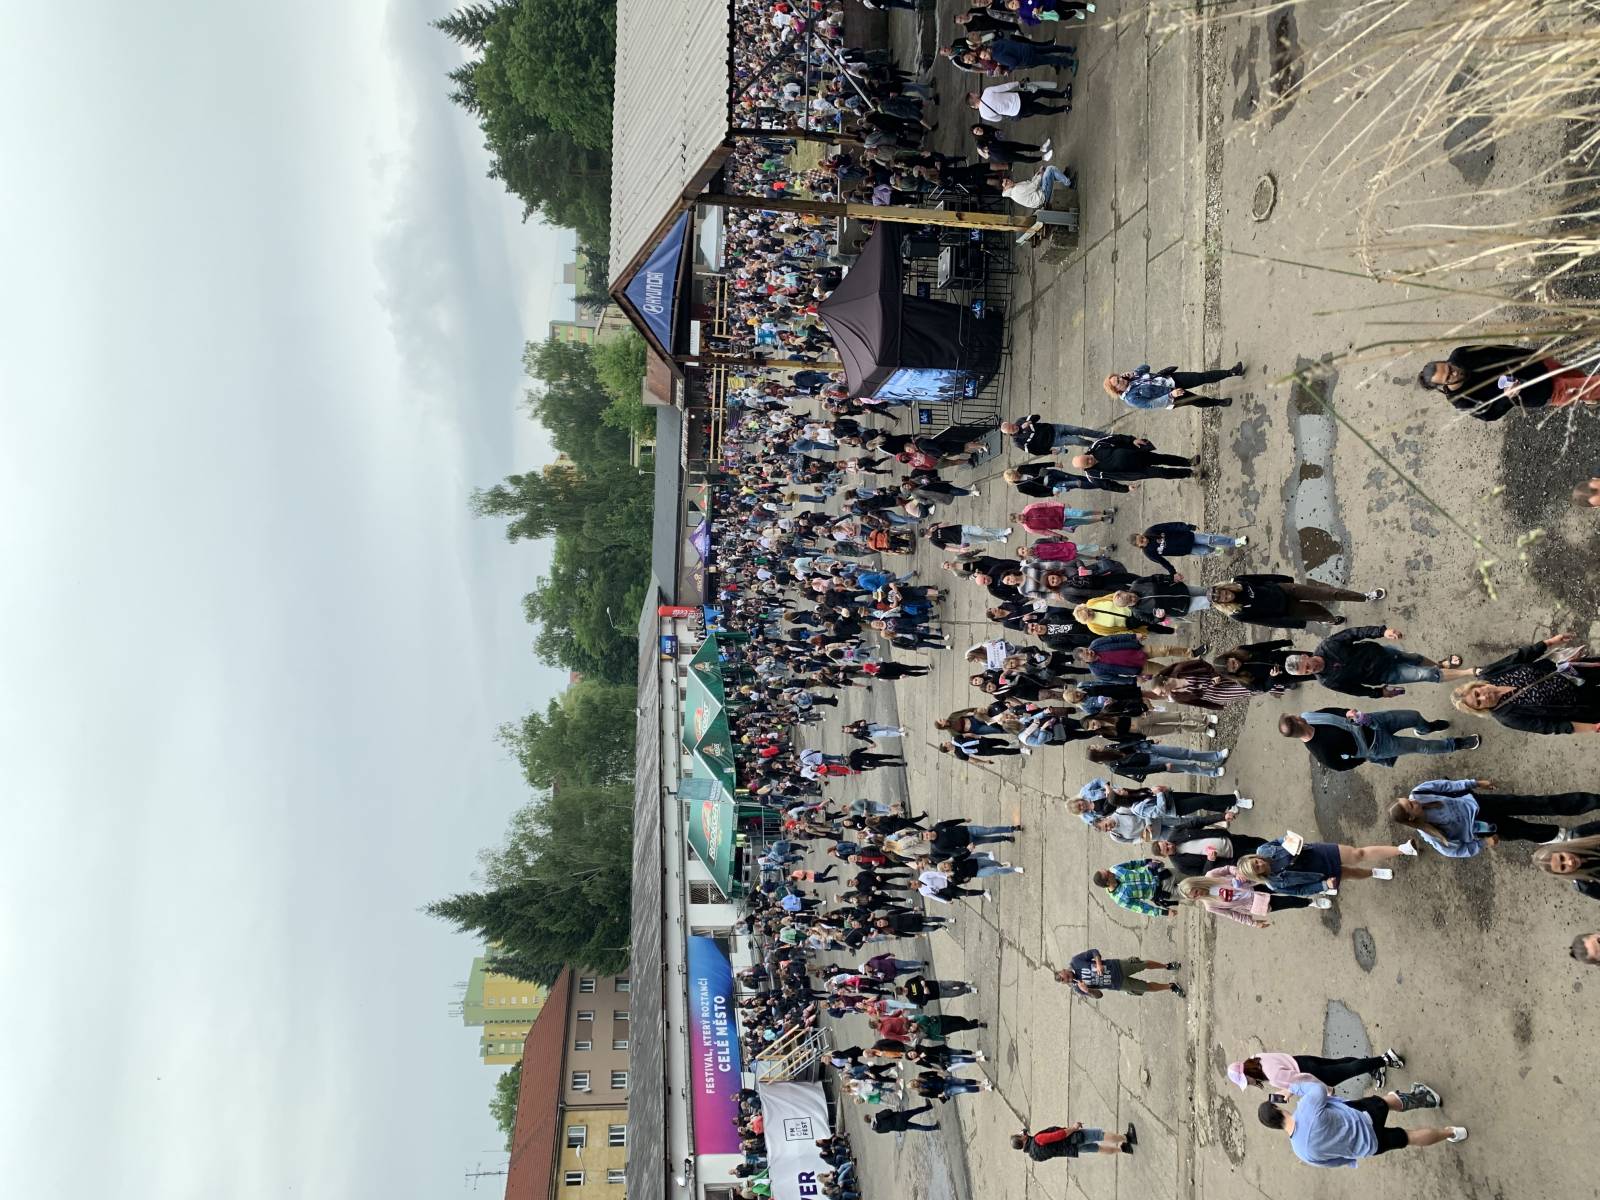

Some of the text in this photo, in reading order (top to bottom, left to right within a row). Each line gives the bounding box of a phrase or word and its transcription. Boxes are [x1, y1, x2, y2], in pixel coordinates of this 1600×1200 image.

[646, 272, 664, 304] HYUNDAI
[698, 978, 715, 1094] FESTIVAL, KTERÝ ROZTANČÍ
[712, 996, 731, 1072] CELÉ MĚSTO
[798, 1171, 818, 1200] ER
